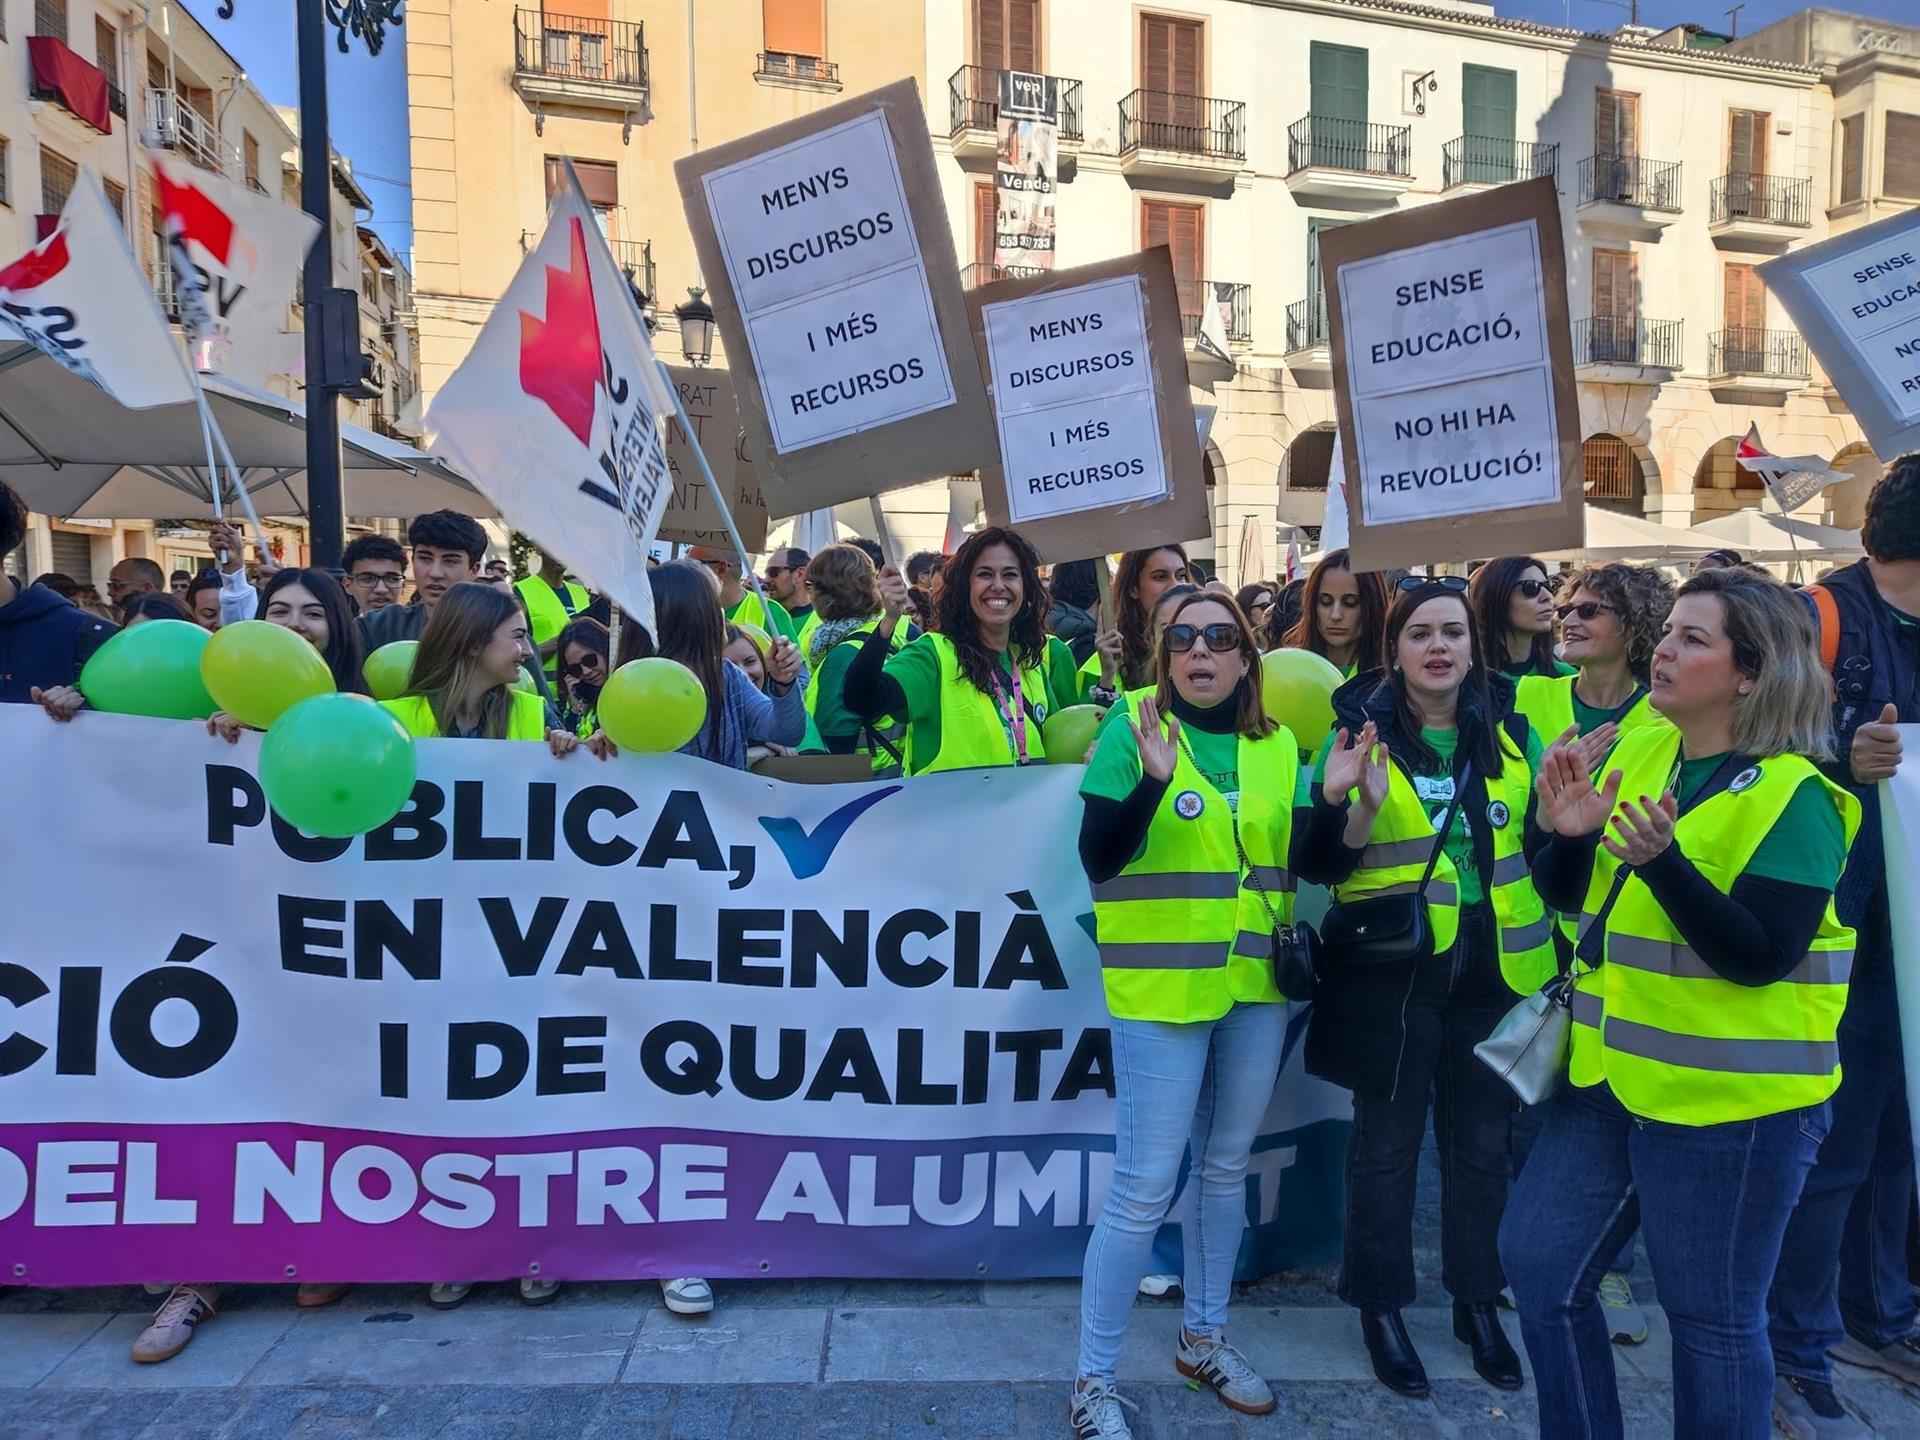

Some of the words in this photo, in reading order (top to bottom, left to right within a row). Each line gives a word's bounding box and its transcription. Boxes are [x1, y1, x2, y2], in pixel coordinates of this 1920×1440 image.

[762, 167, 849, 215] MENYS
[1003, 174, 1051, 192] Vende
[747, 212, 894, 280] DISCURSOS
[1396, 268, 1484, 307] SENSE
[1853, 252, 1916, 283] SENSE
[1852, 280, 1920, 319] EDUCA
[807, 331, 815, 352] I
[825, 311, 878, 347] MÉS
[1029, 313, 1103, 343] MENYS
[1371, 312, 1521, 365] EDUCACIÓ,
[790, 358, 924, 415] RECURSOS
[1010, 350, 1134, 389] DISCURSOS
[1049, 431, 1055, 448] I
[1065, 419, 1110, 444] MÉS
[1395, 417, 1434, 441] NO
[1440, 409, 1469, 433] HI
[1476, 403, 1516, 428] HA
[1028, 458, 1144, 495] RECURSOS
[1380, 450, 1542, 494] REVOLUCIÓ!
[277, 893, 443, 981] EN
[478, 889, 1070, 991] VALENCIÀ
[379, 1022, 409, 1099] I
[447, 1015, 607, 1101] DE
[233, 1140, 728, 1229] NOSTRE
